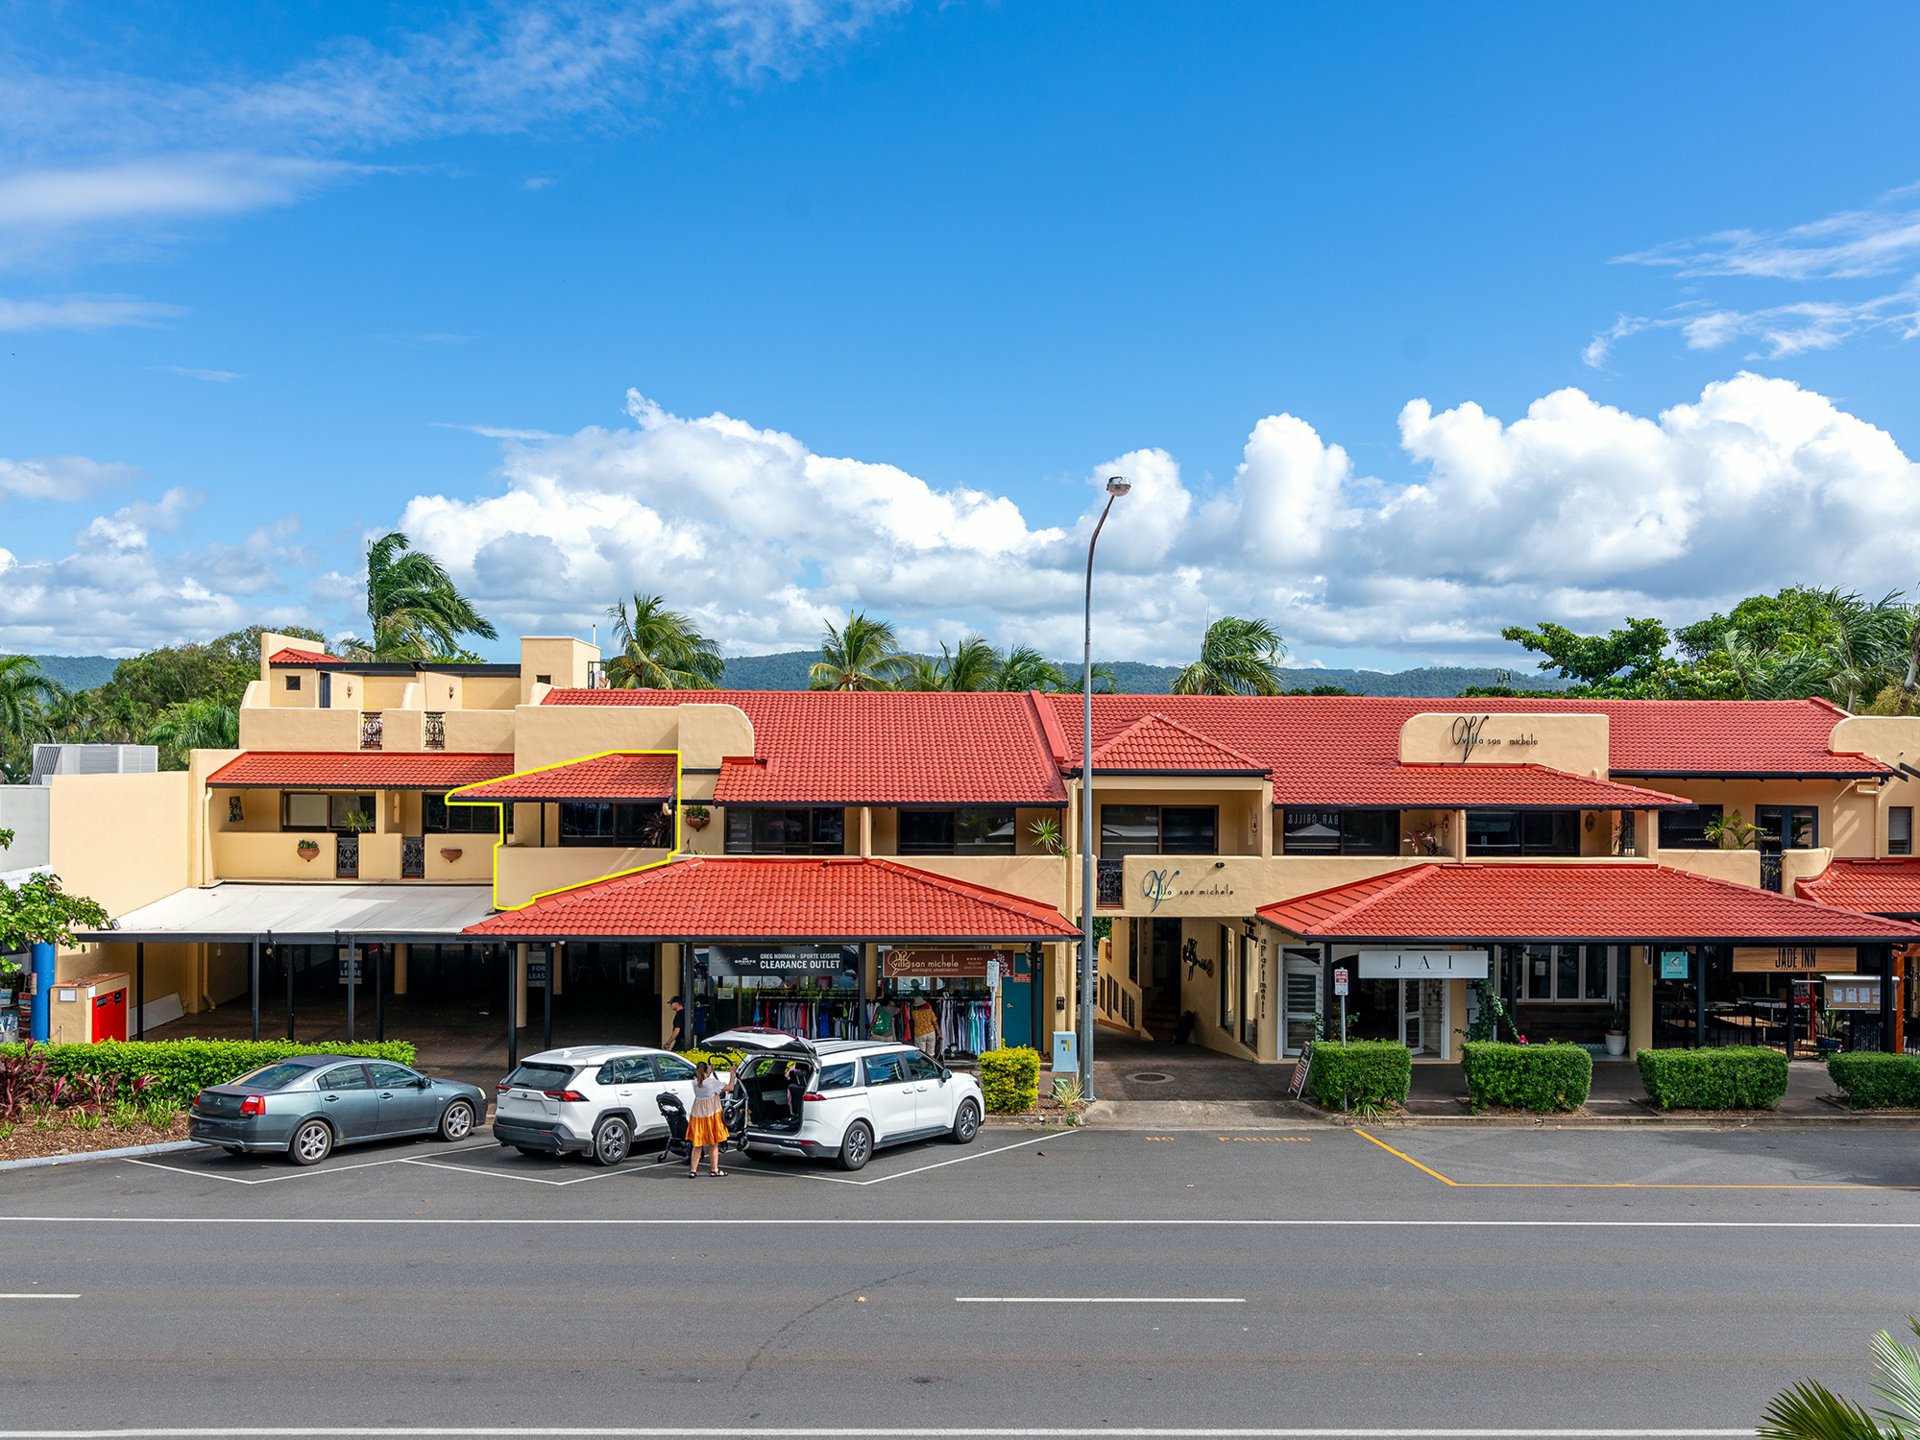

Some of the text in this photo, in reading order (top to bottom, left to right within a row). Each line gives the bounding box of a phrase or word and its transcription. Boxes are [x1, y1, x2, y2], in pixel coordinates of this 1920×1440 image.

[1509, 733, 1539, 745] michele
[1198, 883, 1234, 896] michele
[911, 960, 926, 968] san
[927, 953, 959, 968] michele
[1775, 948, 1816, 968] JADE INN
[760, 960, 808, 970] CLEARANCE
[809, 960, 840, 969] OUTLET
